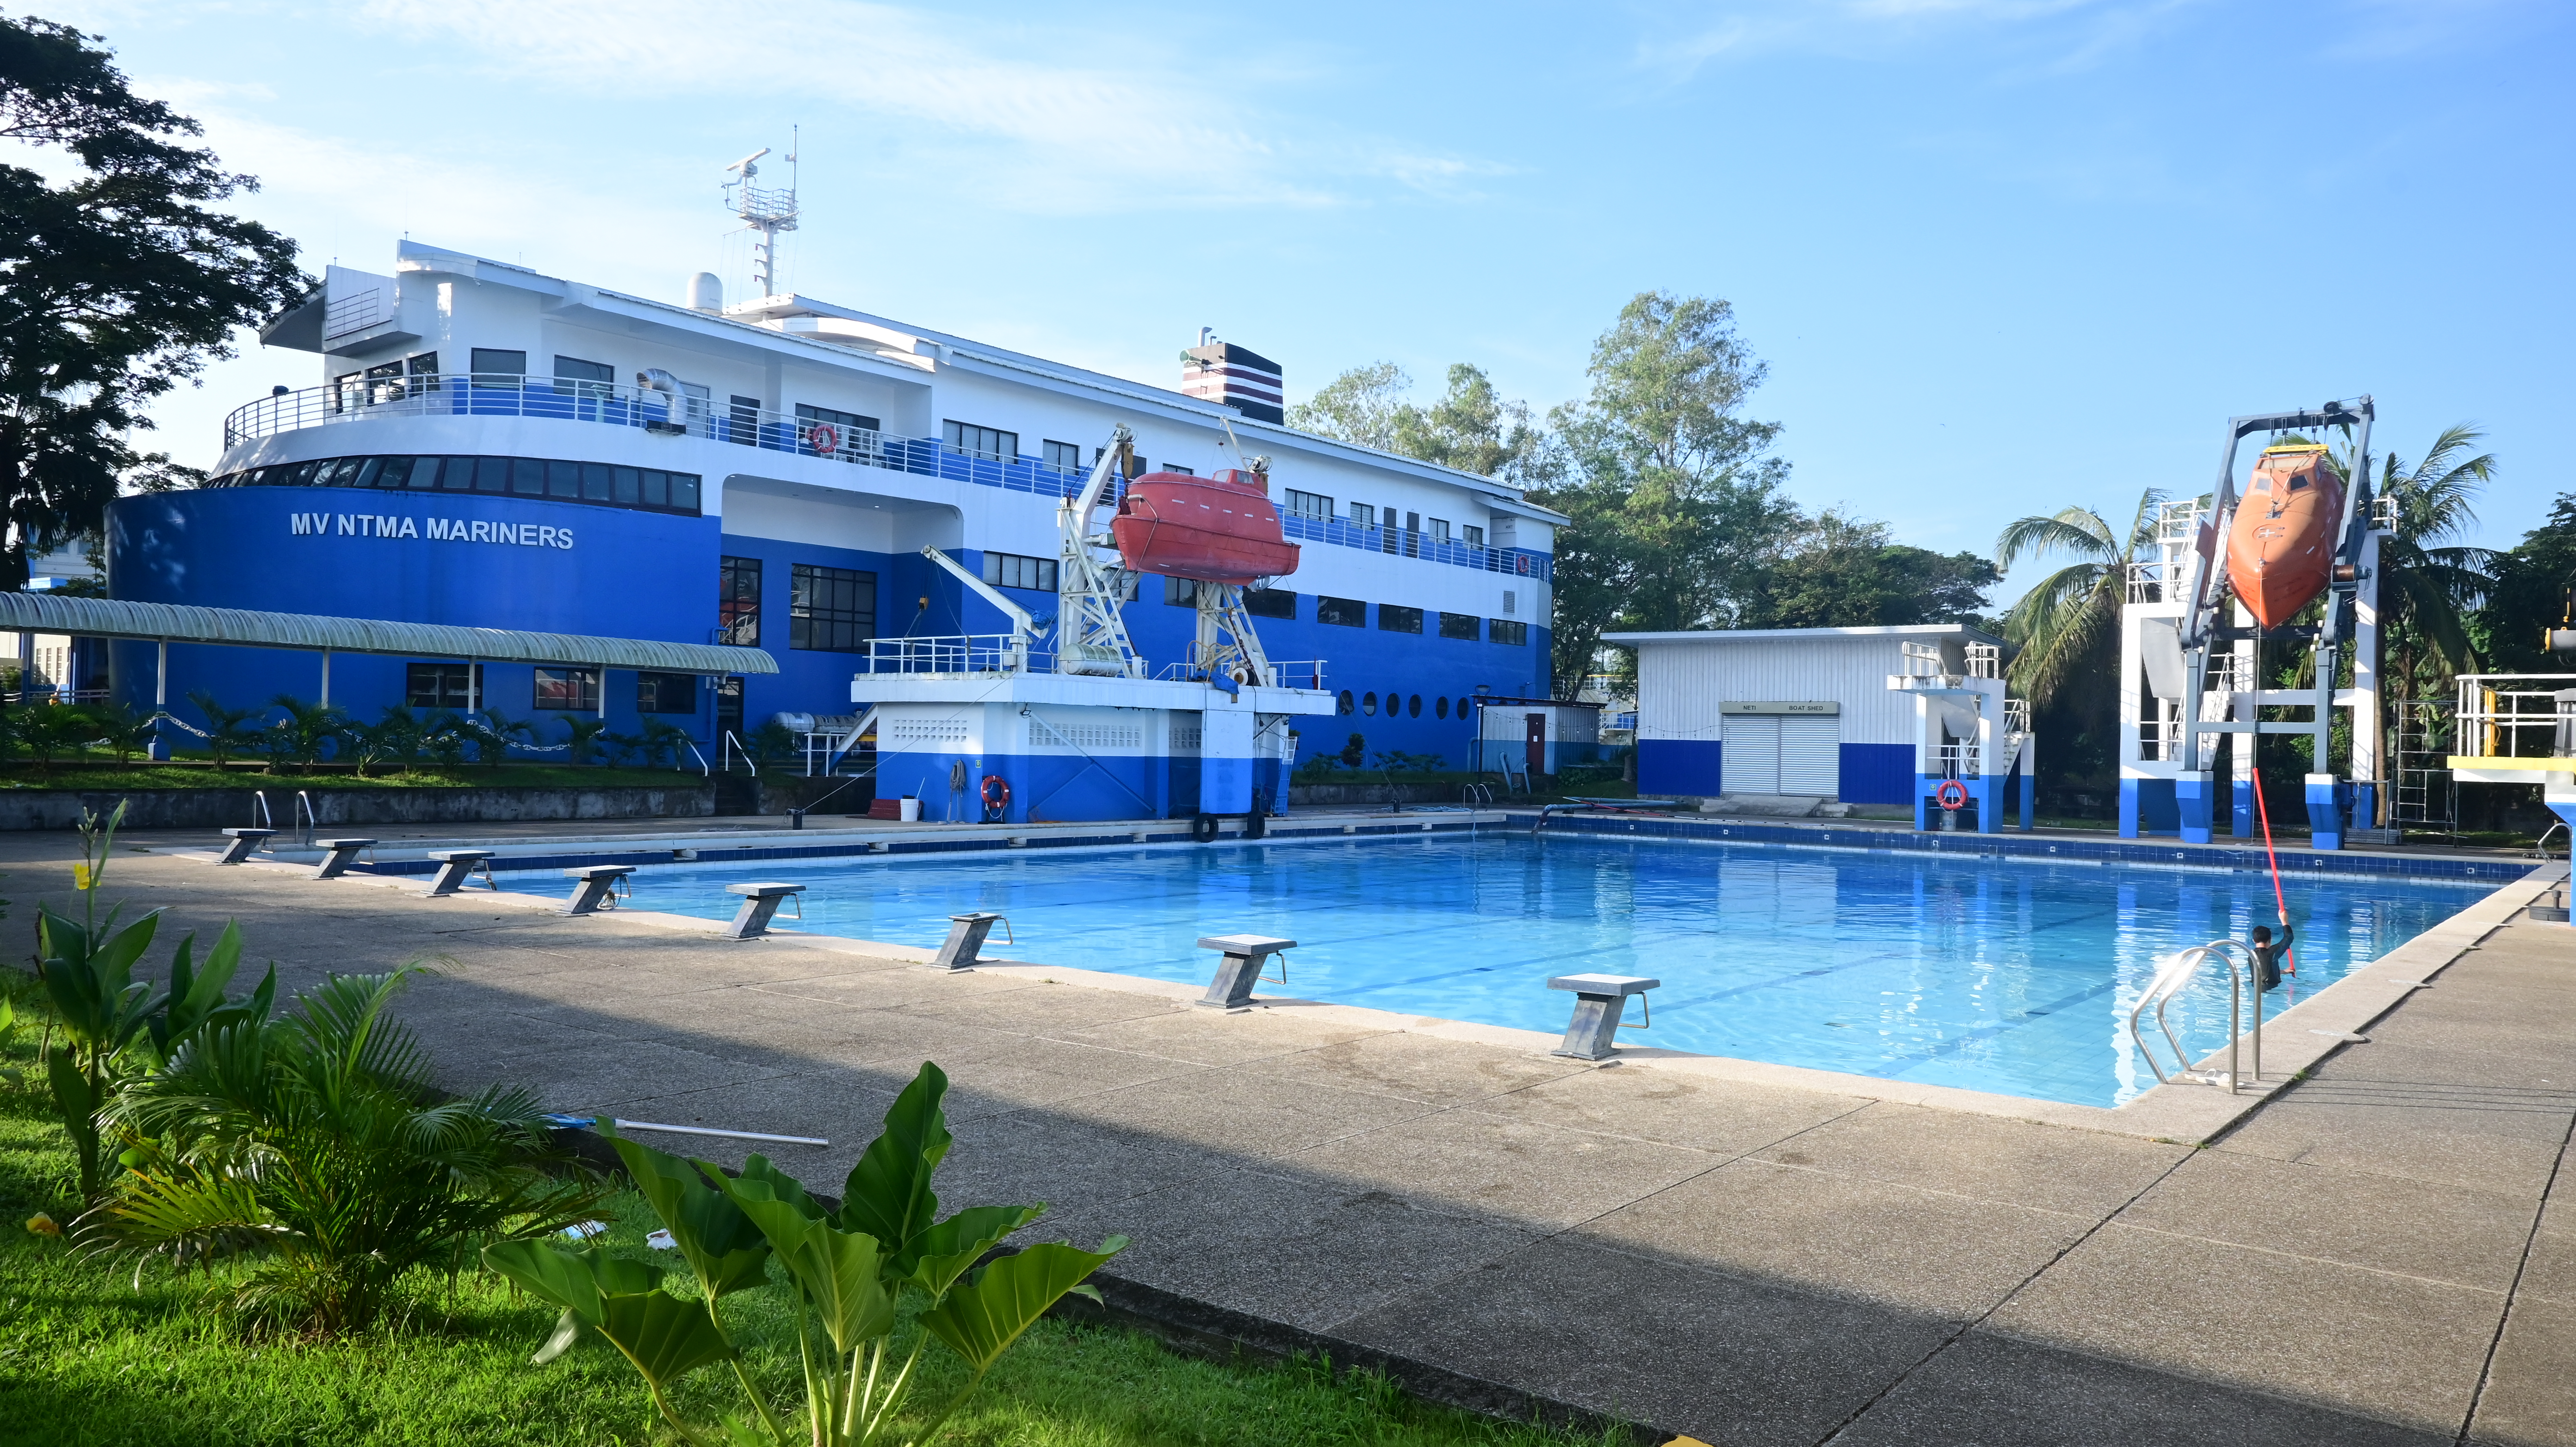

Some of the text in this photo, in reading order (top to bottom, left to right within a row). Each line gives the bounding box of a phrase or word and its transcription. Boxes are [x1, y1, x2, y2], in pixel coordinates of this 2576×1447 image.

[291, 513, 574, 550] MV NTMA MARINERS
